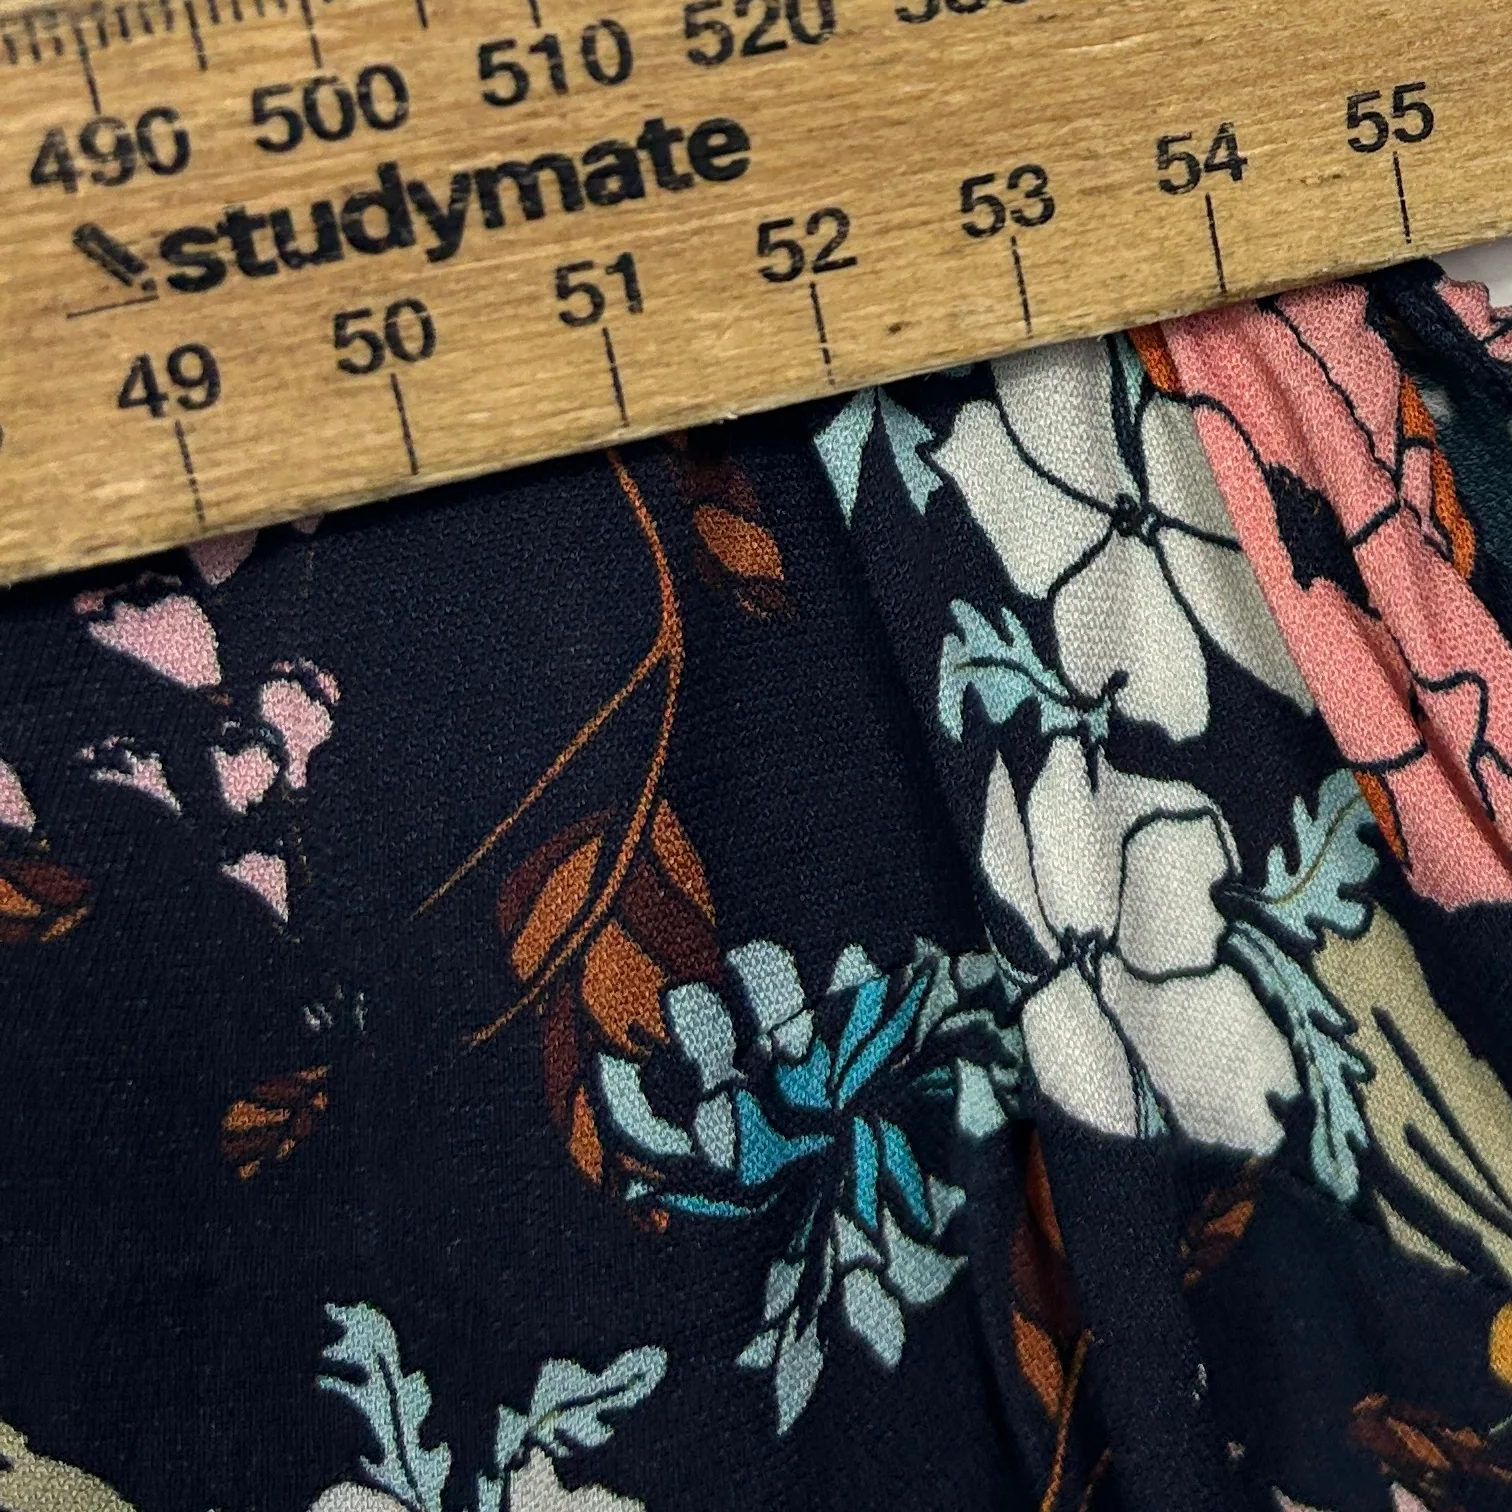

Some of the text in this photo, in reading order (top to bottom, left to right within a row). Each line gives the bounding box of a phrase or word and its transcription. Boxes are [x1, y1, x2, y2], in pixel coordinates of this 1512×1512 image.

[29, 106, 192, 193] 490
[250, 63, 410, 153] 500
[476, 18, 634, 107] 510
[116, 343, 222, 419] 49
[332, 298, 436, 375] 50
[554, 252, 644, 328] 51
[756, 206, 858, 284] 52
[959, 164, 1055, 239] 53
[1155, 122, 1248, 194] 54
[1346, 82, 1434, 153] 55
[158, 115, 751, 294] studymate
